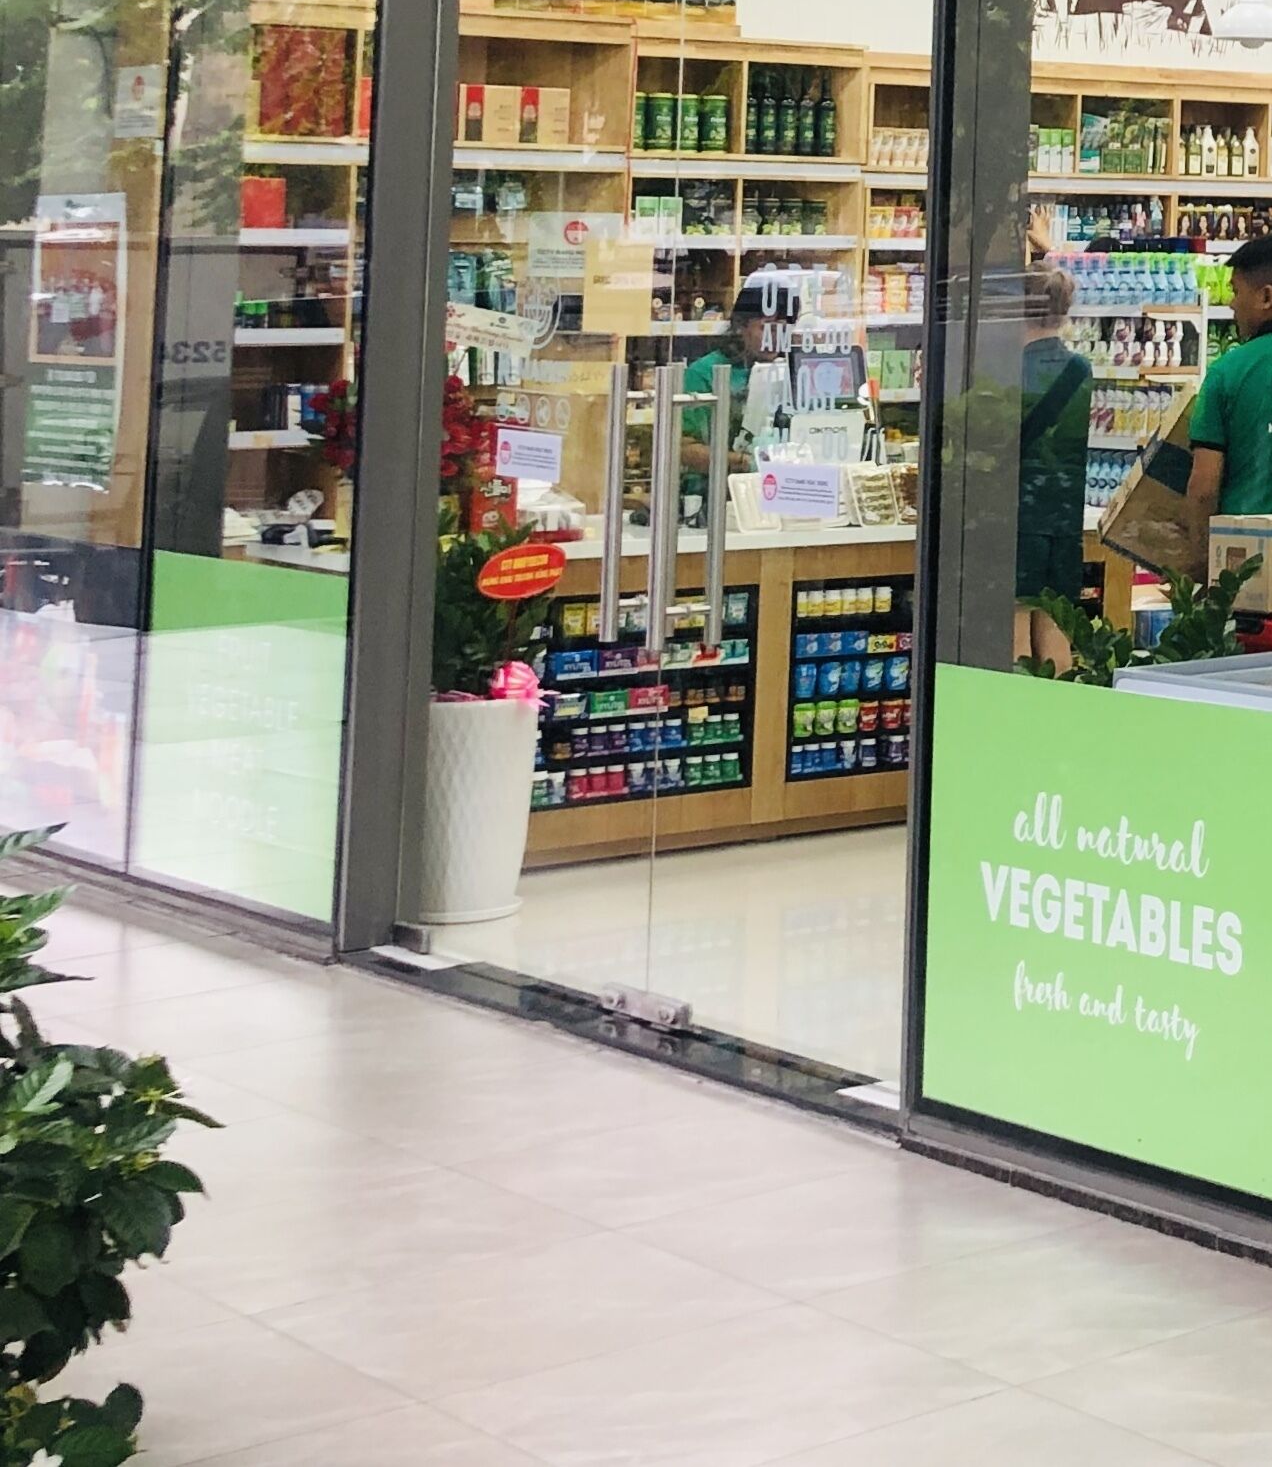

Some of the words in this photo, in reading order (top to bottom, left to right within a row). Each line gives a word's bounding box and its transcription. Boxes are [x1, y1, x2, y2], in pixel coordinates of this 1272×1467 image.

[1013, 790, 1068, 850] all
[1077, 814, 1210, 878] natural
[980, 860, 1244, 976] VEGETABLES
[1013, 959, 1071, 1012] fresh
[1079, 984, 1128, 1025] and
[1134, 995, 1200, 1062] tasty
